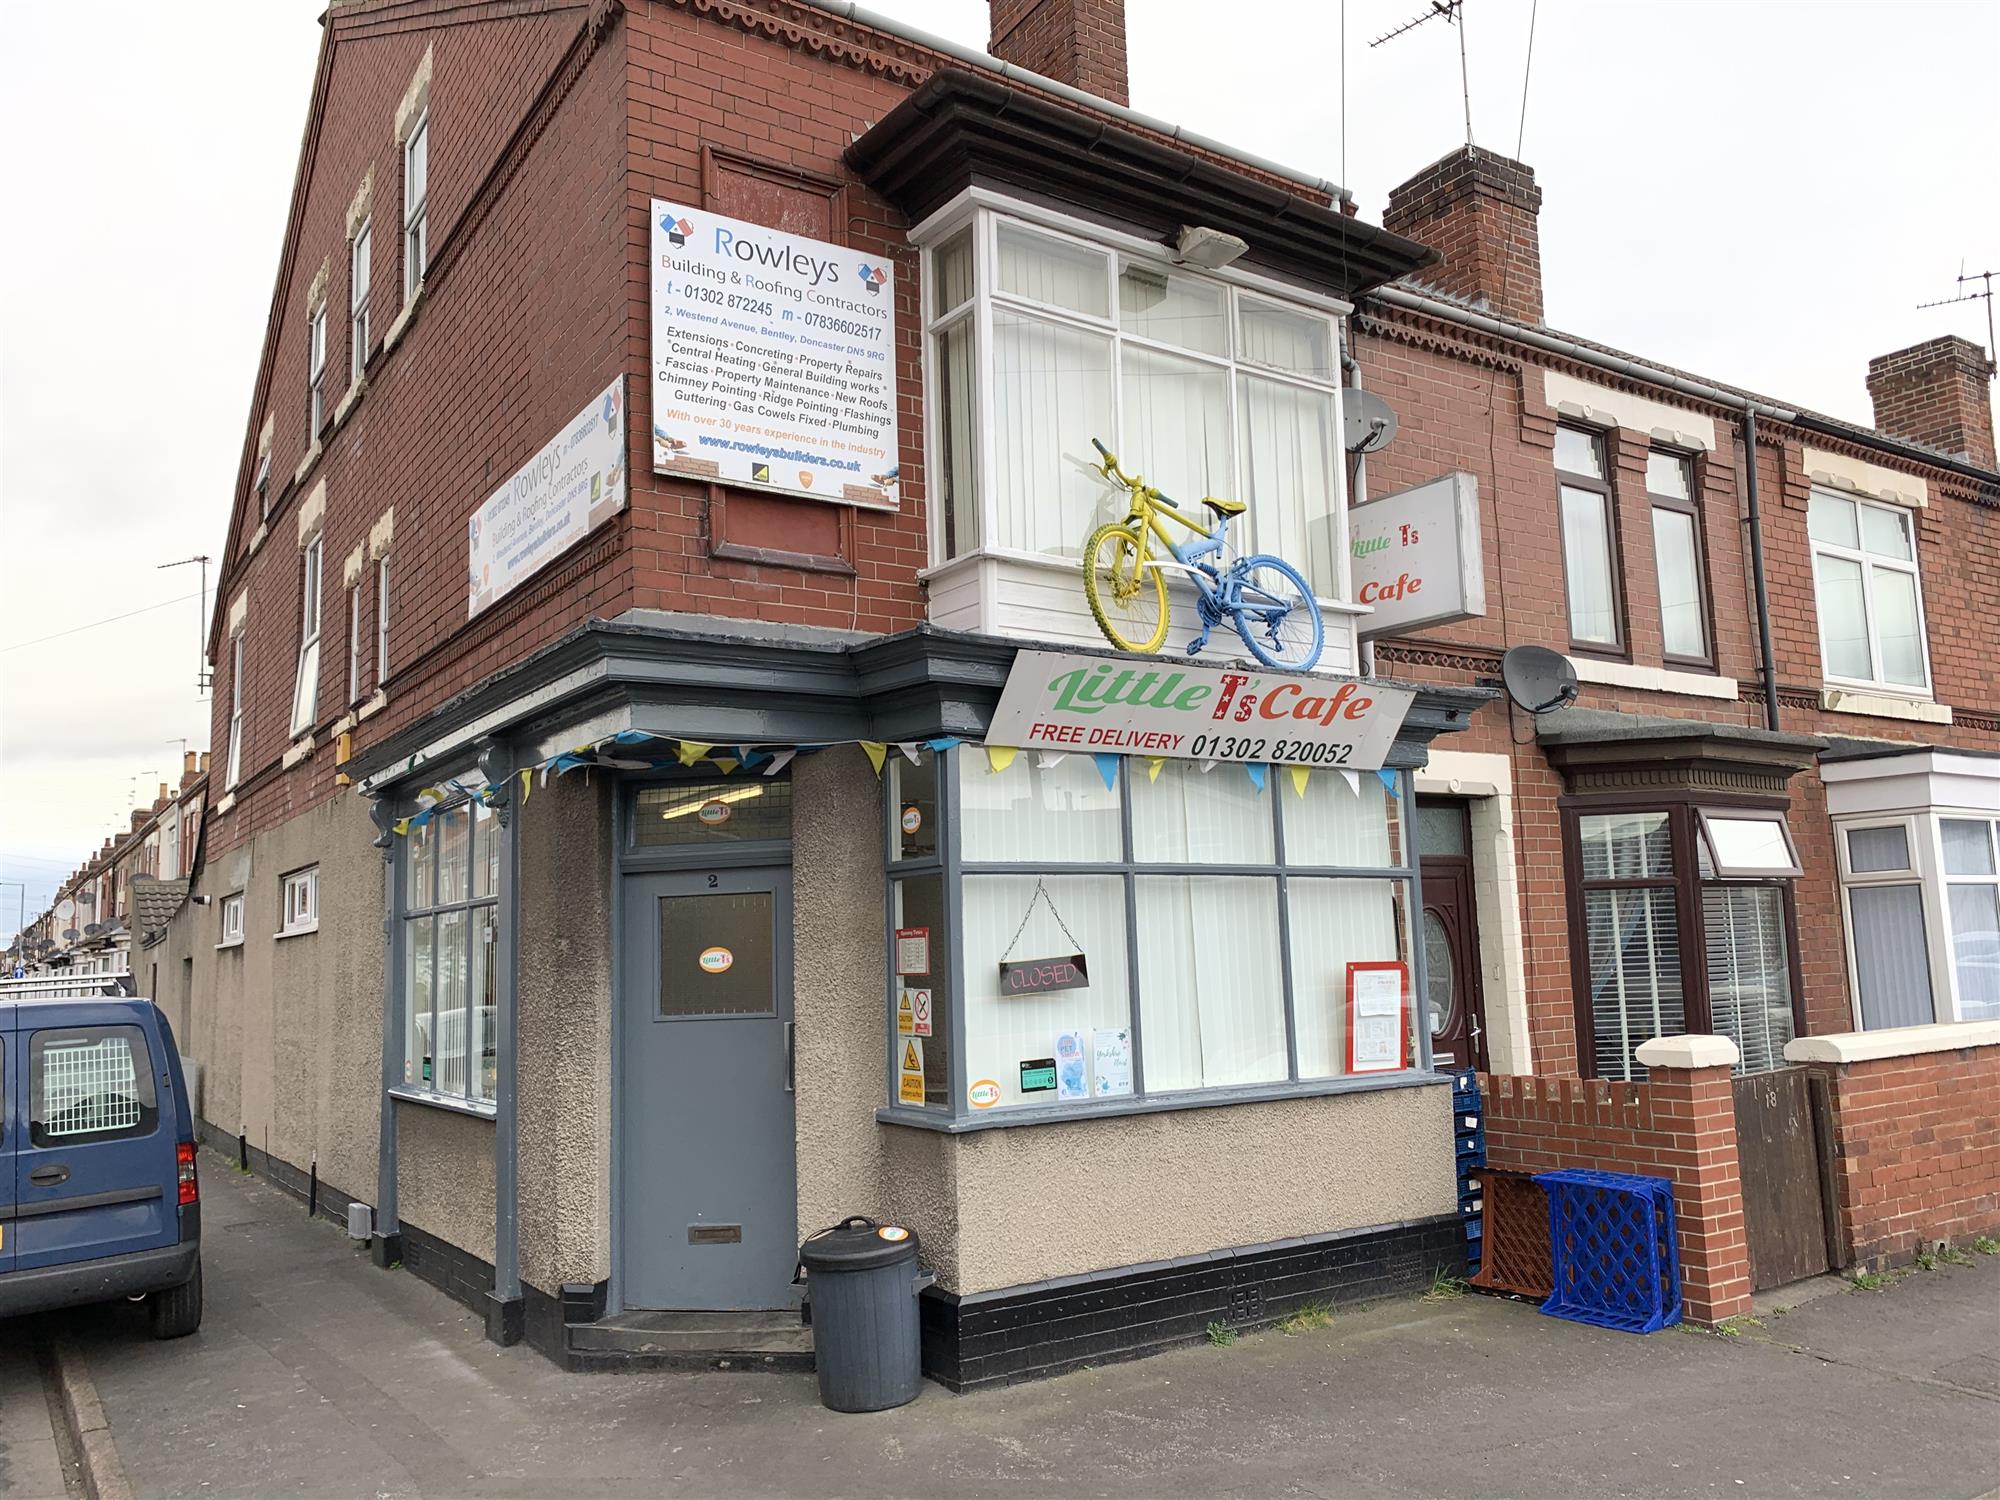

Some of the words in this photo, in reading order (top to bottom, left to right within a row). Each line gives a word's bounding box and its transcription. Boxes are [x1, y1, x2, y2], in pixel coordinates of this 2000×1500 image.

[715, 227, 840, 286] Rowleys
[661, 254, 726, 284] Building
[730, 270, 741, 285] &
[745, 274, 802, 302] Roofing
[807, 289, 888, 319] Contractors
[667, 280, 673, 294] t
[684, 284, 724, 305] 01302
[727, 294, 773, 316] 872245
[664, 305, 673, 316] 2,
[676, 307, 718, 324] Westend
[720, 318, 758, 334] Avenue,
[760, 327, 797, 343] Bentley,
[800, 335, 845, 353] Doncaster
[847, 345, 865, 358] DN5
[866, 350, 885, 361] 9RG
[782, 308, 794, 321] m
[804, 312, 882, 341] 07836602517
[666, 326, 729, 348] Extensions
[735, 340, 794, 363] Concreting
[799, 354, 843, 374] Property
[845, 364, 883, 381] Repairs
[671, 342, 712, 359] Central
[715, 351, 756, 371] Heating
[762, 361, 803, 379] General
[806, 370, 848, 390] Building
[850, 380, 880, 395] works
[658, 371, 709, 391] Chimney
[711, 381, 757, 401] Pointing
[763, 391, 794, 407] Ridge
[796, 398, 839, 417] Pointing
[844, 407, 892, 426] Flashings
[665, 357, 709, 374] Fascias
[715, 366, 762, 387] Property
[764, 376, 830, 399] Maintenance
[835, 391, 857, 404] New
[859, 396, 888, 411] Roofs
[666, 408, 691, 421] With
[694, 415, 717, 426] over
[719, 418, 732, 429] 30
[734, 422, 761, 435] years
[764, 428, 818, 445] experience
[819, 437, 829, 447] in
[831, 439, 846, 450] the
[848, 443, 886, 459] industry
[674, 389, 727, 411] Guttering
[733, 400, 754, 414] Gas
[757, 405, 796, 422] Cowels
[798, 413, 827, 428] Fixed
[832, 419, 880, 440] Plumbing
[513, 444, 561, 506] Rowleys
[698, 435, 862, 473] www.rowleysbuilders.co.uk
[516, 511, 522, 528] &
[548, 457, 589, 500] Contractors
[1351, 535, 1391, 559] Little
[1359, 573, 1422, 605] Cafe
[1047, 664, 1213, 714] Little
[1212, 674, 1261, 722] T's
[1258, 683, 1374, 727] Cafe
[1028, 723, 1086, 743] FREE
[1087, 728, 1185, 750] DELIVERY
[1191, 734, 1266, 759] 01302
[1271, 739, 1353, 764] 820052
[708, 874, 718, 888] 2
[1010, 963, 1077, 989] CLOSED
[1765, 1091, 1777, 1109] 18
